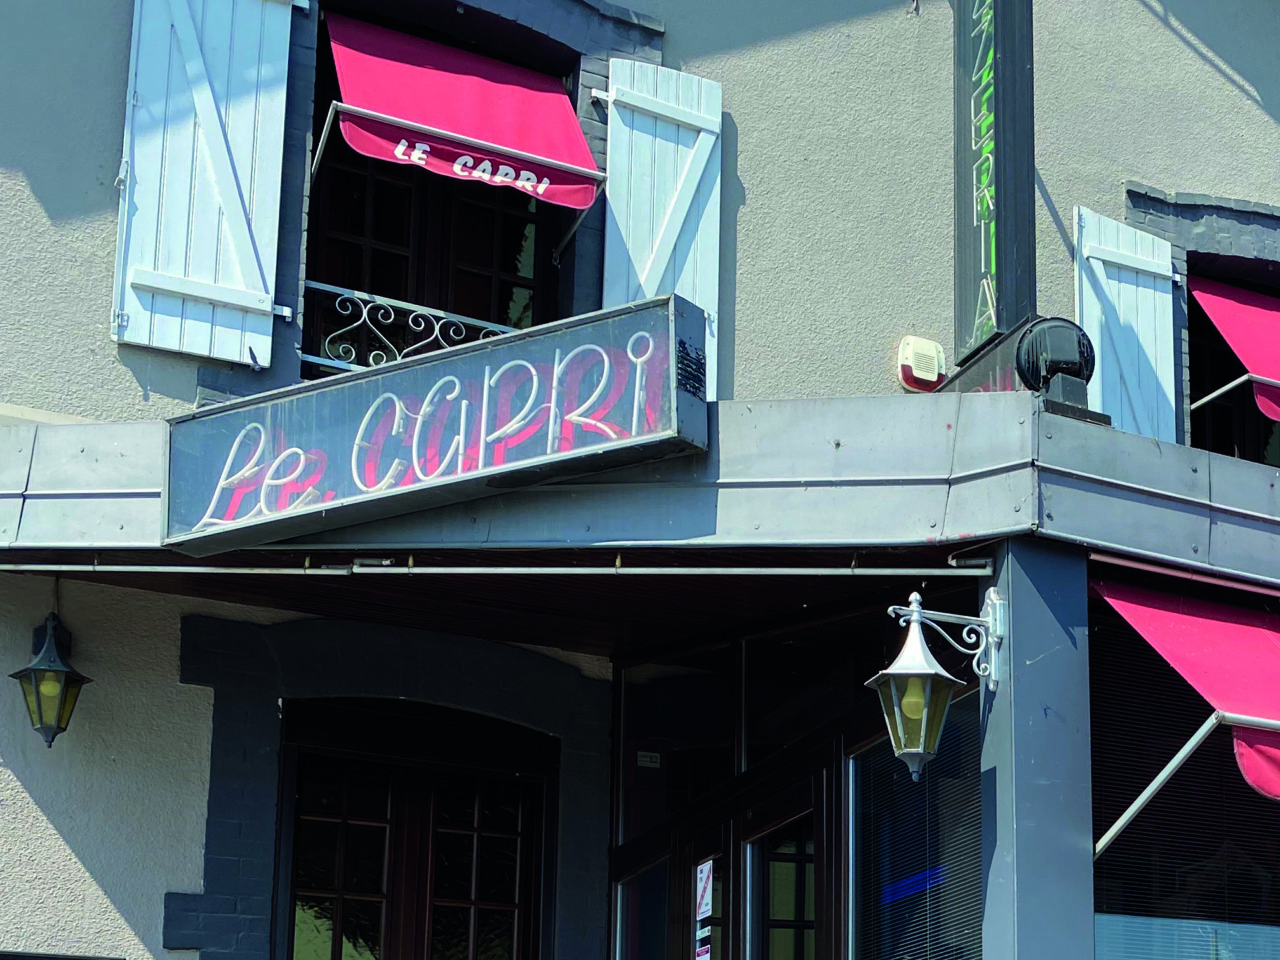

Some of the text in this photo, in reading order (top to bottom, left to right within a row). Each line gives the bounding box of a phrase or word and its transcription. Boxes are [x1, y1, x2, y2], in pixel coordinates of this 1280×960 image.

[393, 138, 550, 195] LE CAPRI
[191, 422, 328, 532] Le
